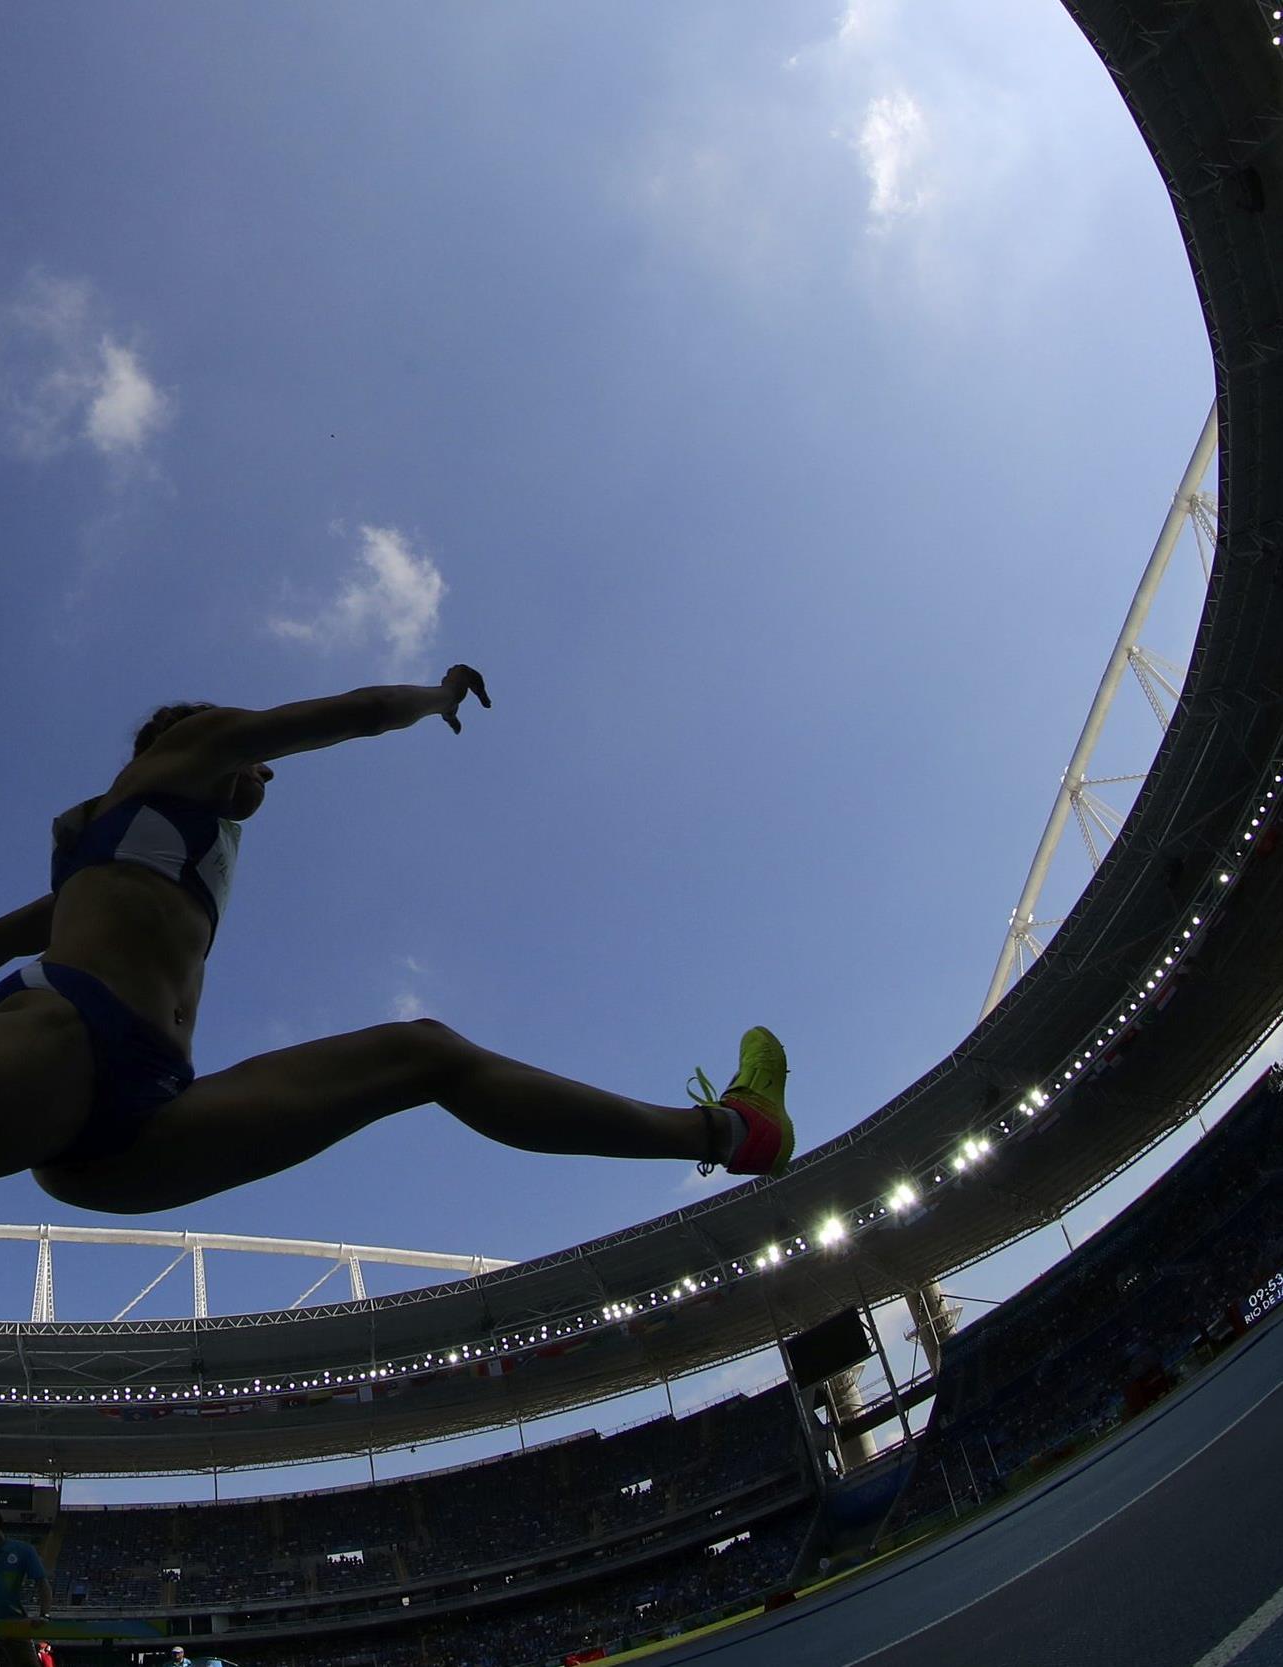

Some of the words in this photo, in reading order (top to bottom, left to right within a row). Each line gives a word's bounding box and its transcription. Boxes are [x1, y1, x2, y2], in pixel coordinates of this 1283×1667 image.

[1249, 1273, 1283, 1306] 09:53
[1244, 1307, 1261, 1324] RIO
[1262, 1295, 1276, 1309] DE
